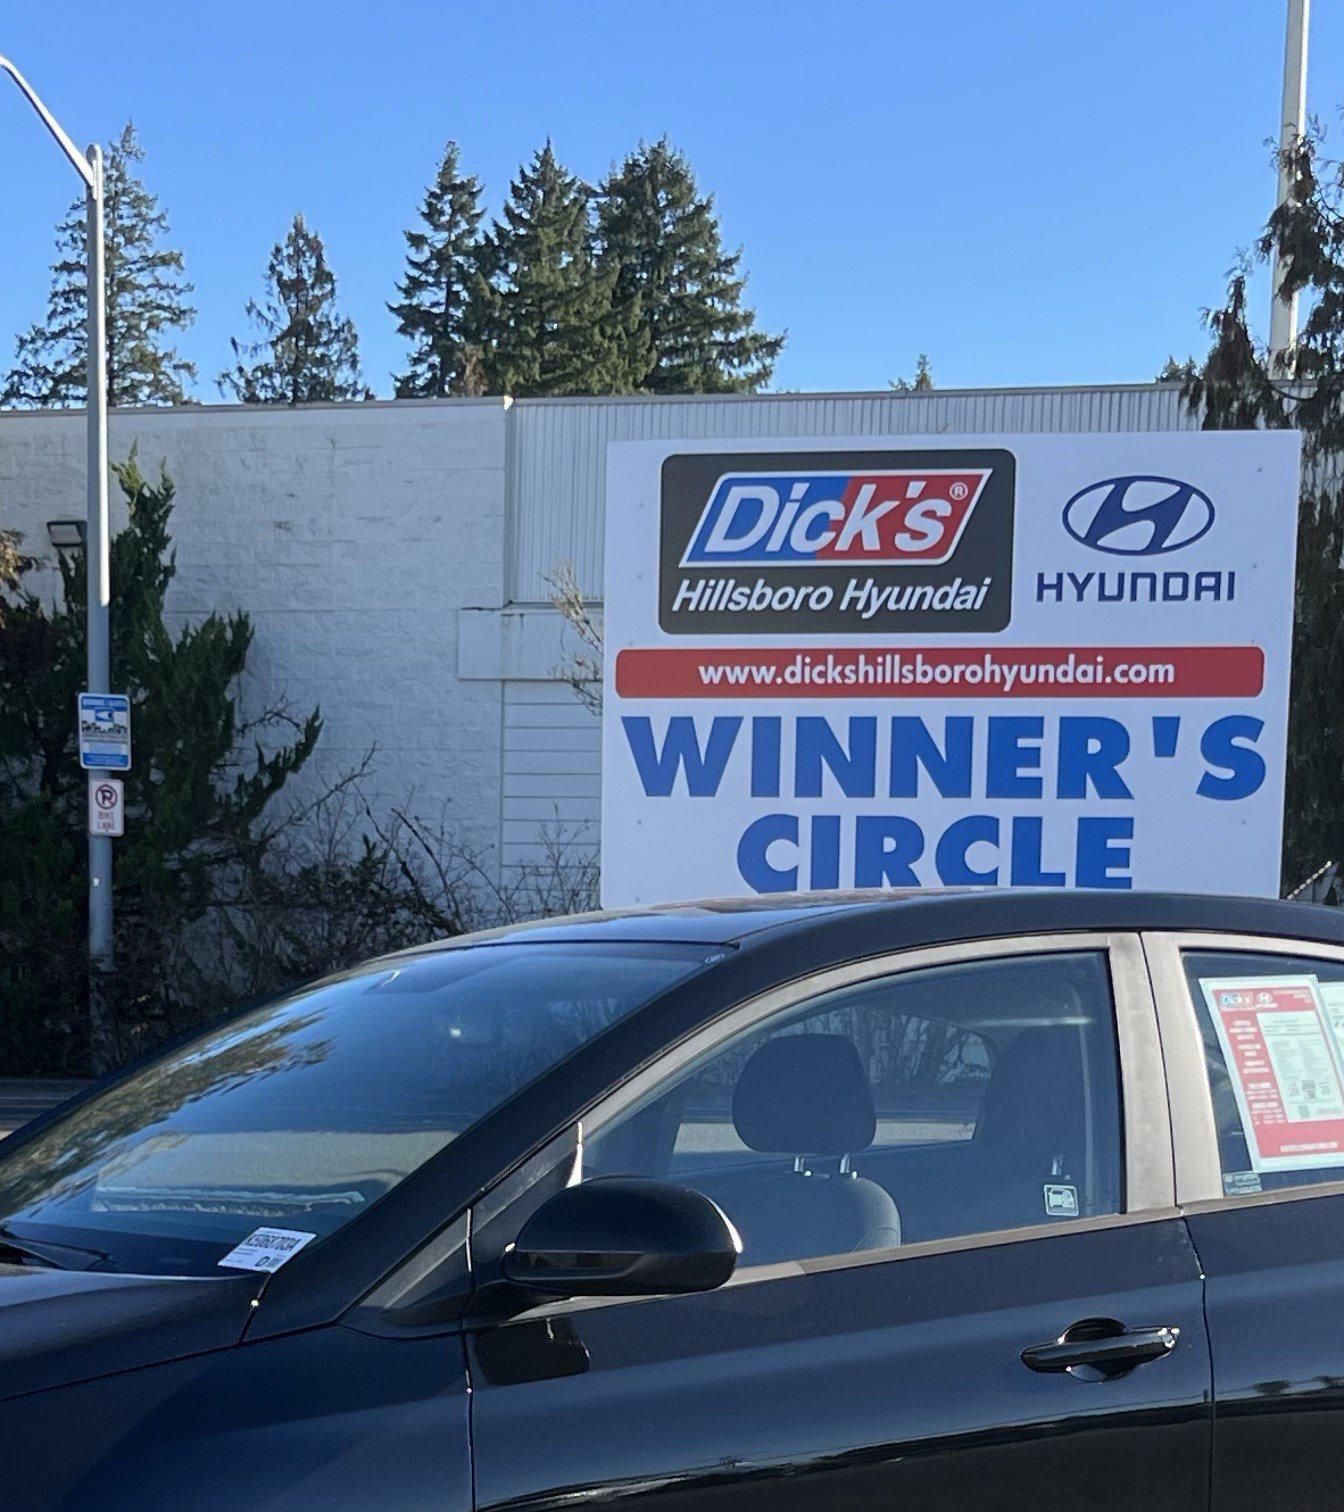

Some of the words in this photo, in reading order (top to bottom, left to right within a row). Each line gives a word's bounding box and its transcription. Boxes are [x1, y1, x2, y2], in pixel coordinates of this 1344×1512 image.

[704, 481, 951, 552] Dick's
[671, 578, 834, 612] Hillsboro
[839, 577, 992, 619] Hyundai
[1036, 571, 1236, 601] HYUNDAI
[698, 655, 1174, 690] www.dickshillsborohyundai.com
[621, 714, 1266, 801] WINNER'S
[737, 814, 1135, 893] CIRCLE
